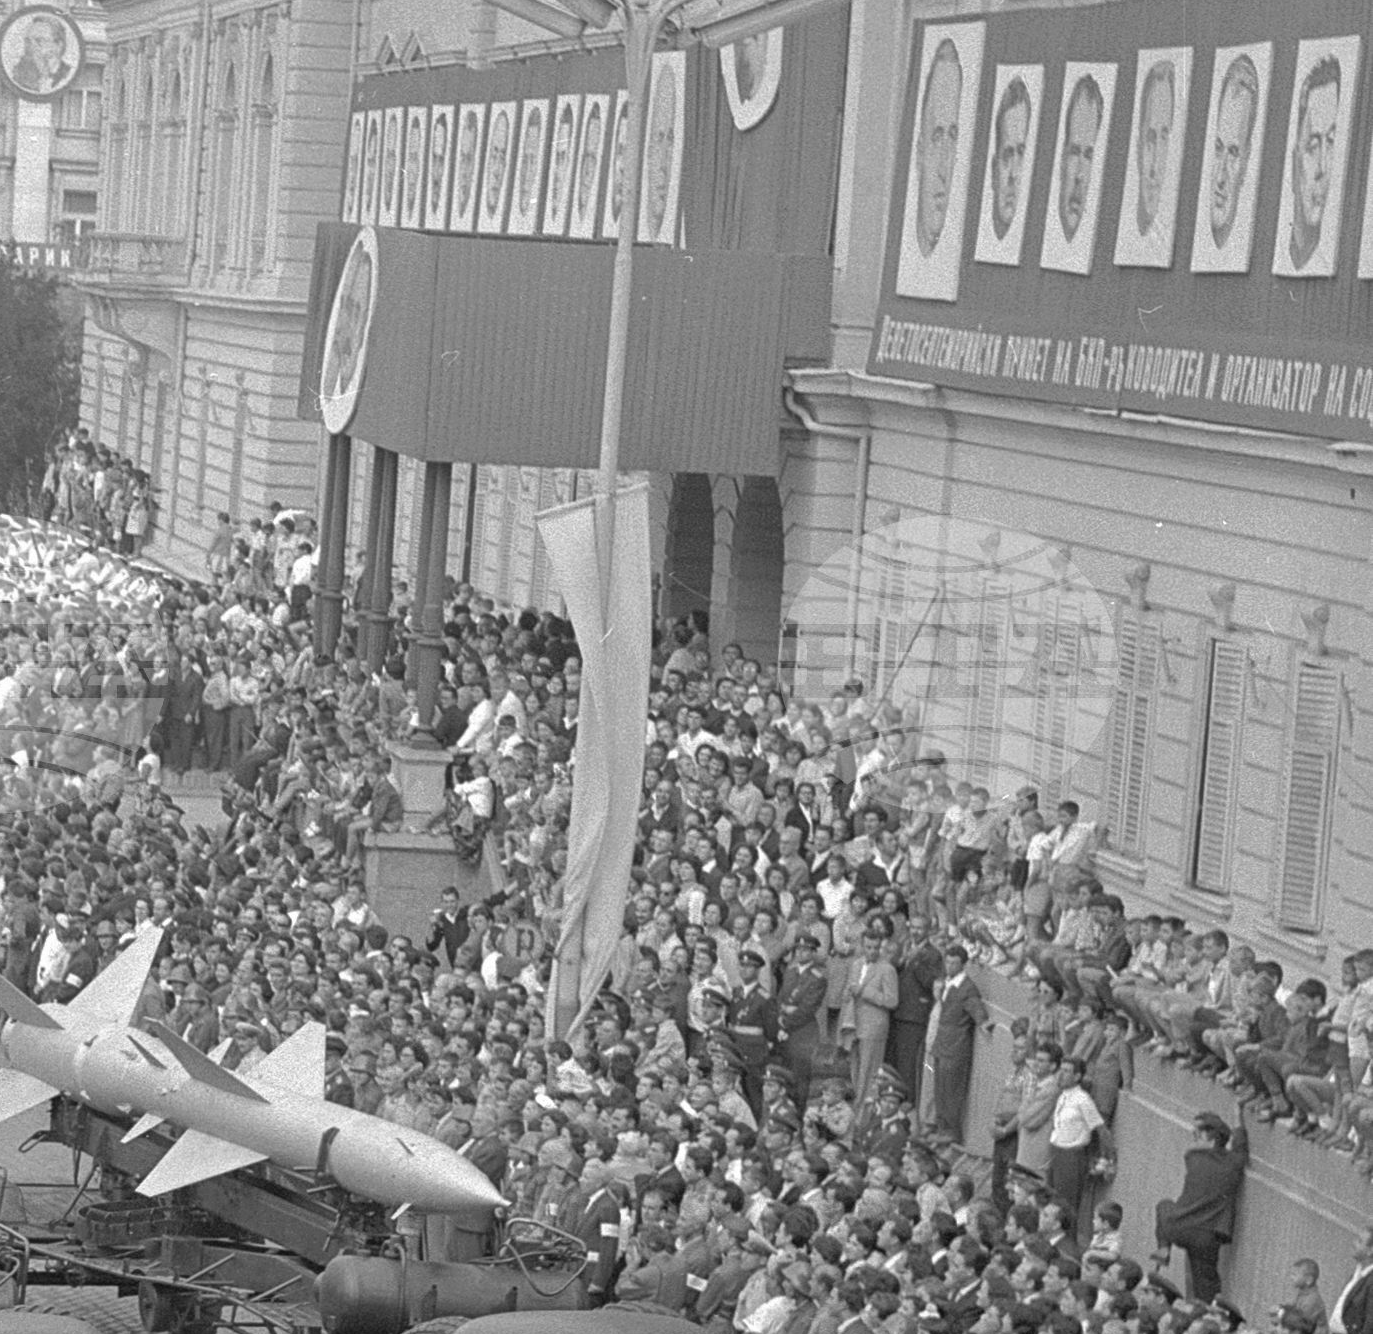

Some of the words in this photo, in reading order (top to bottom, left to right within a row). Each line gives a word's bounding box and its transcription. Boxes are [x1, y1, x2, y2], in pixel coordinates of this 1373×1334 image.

[1002, 335, 1051, 382] ПРИВЕТ
[1052, 339, 1072, 384] НА
[1205, 352, 1220, 399] И
[1221, 354, 1322, 413] ОРГАНИЗАТОР
[1323, 364, 1347, 416] НА
